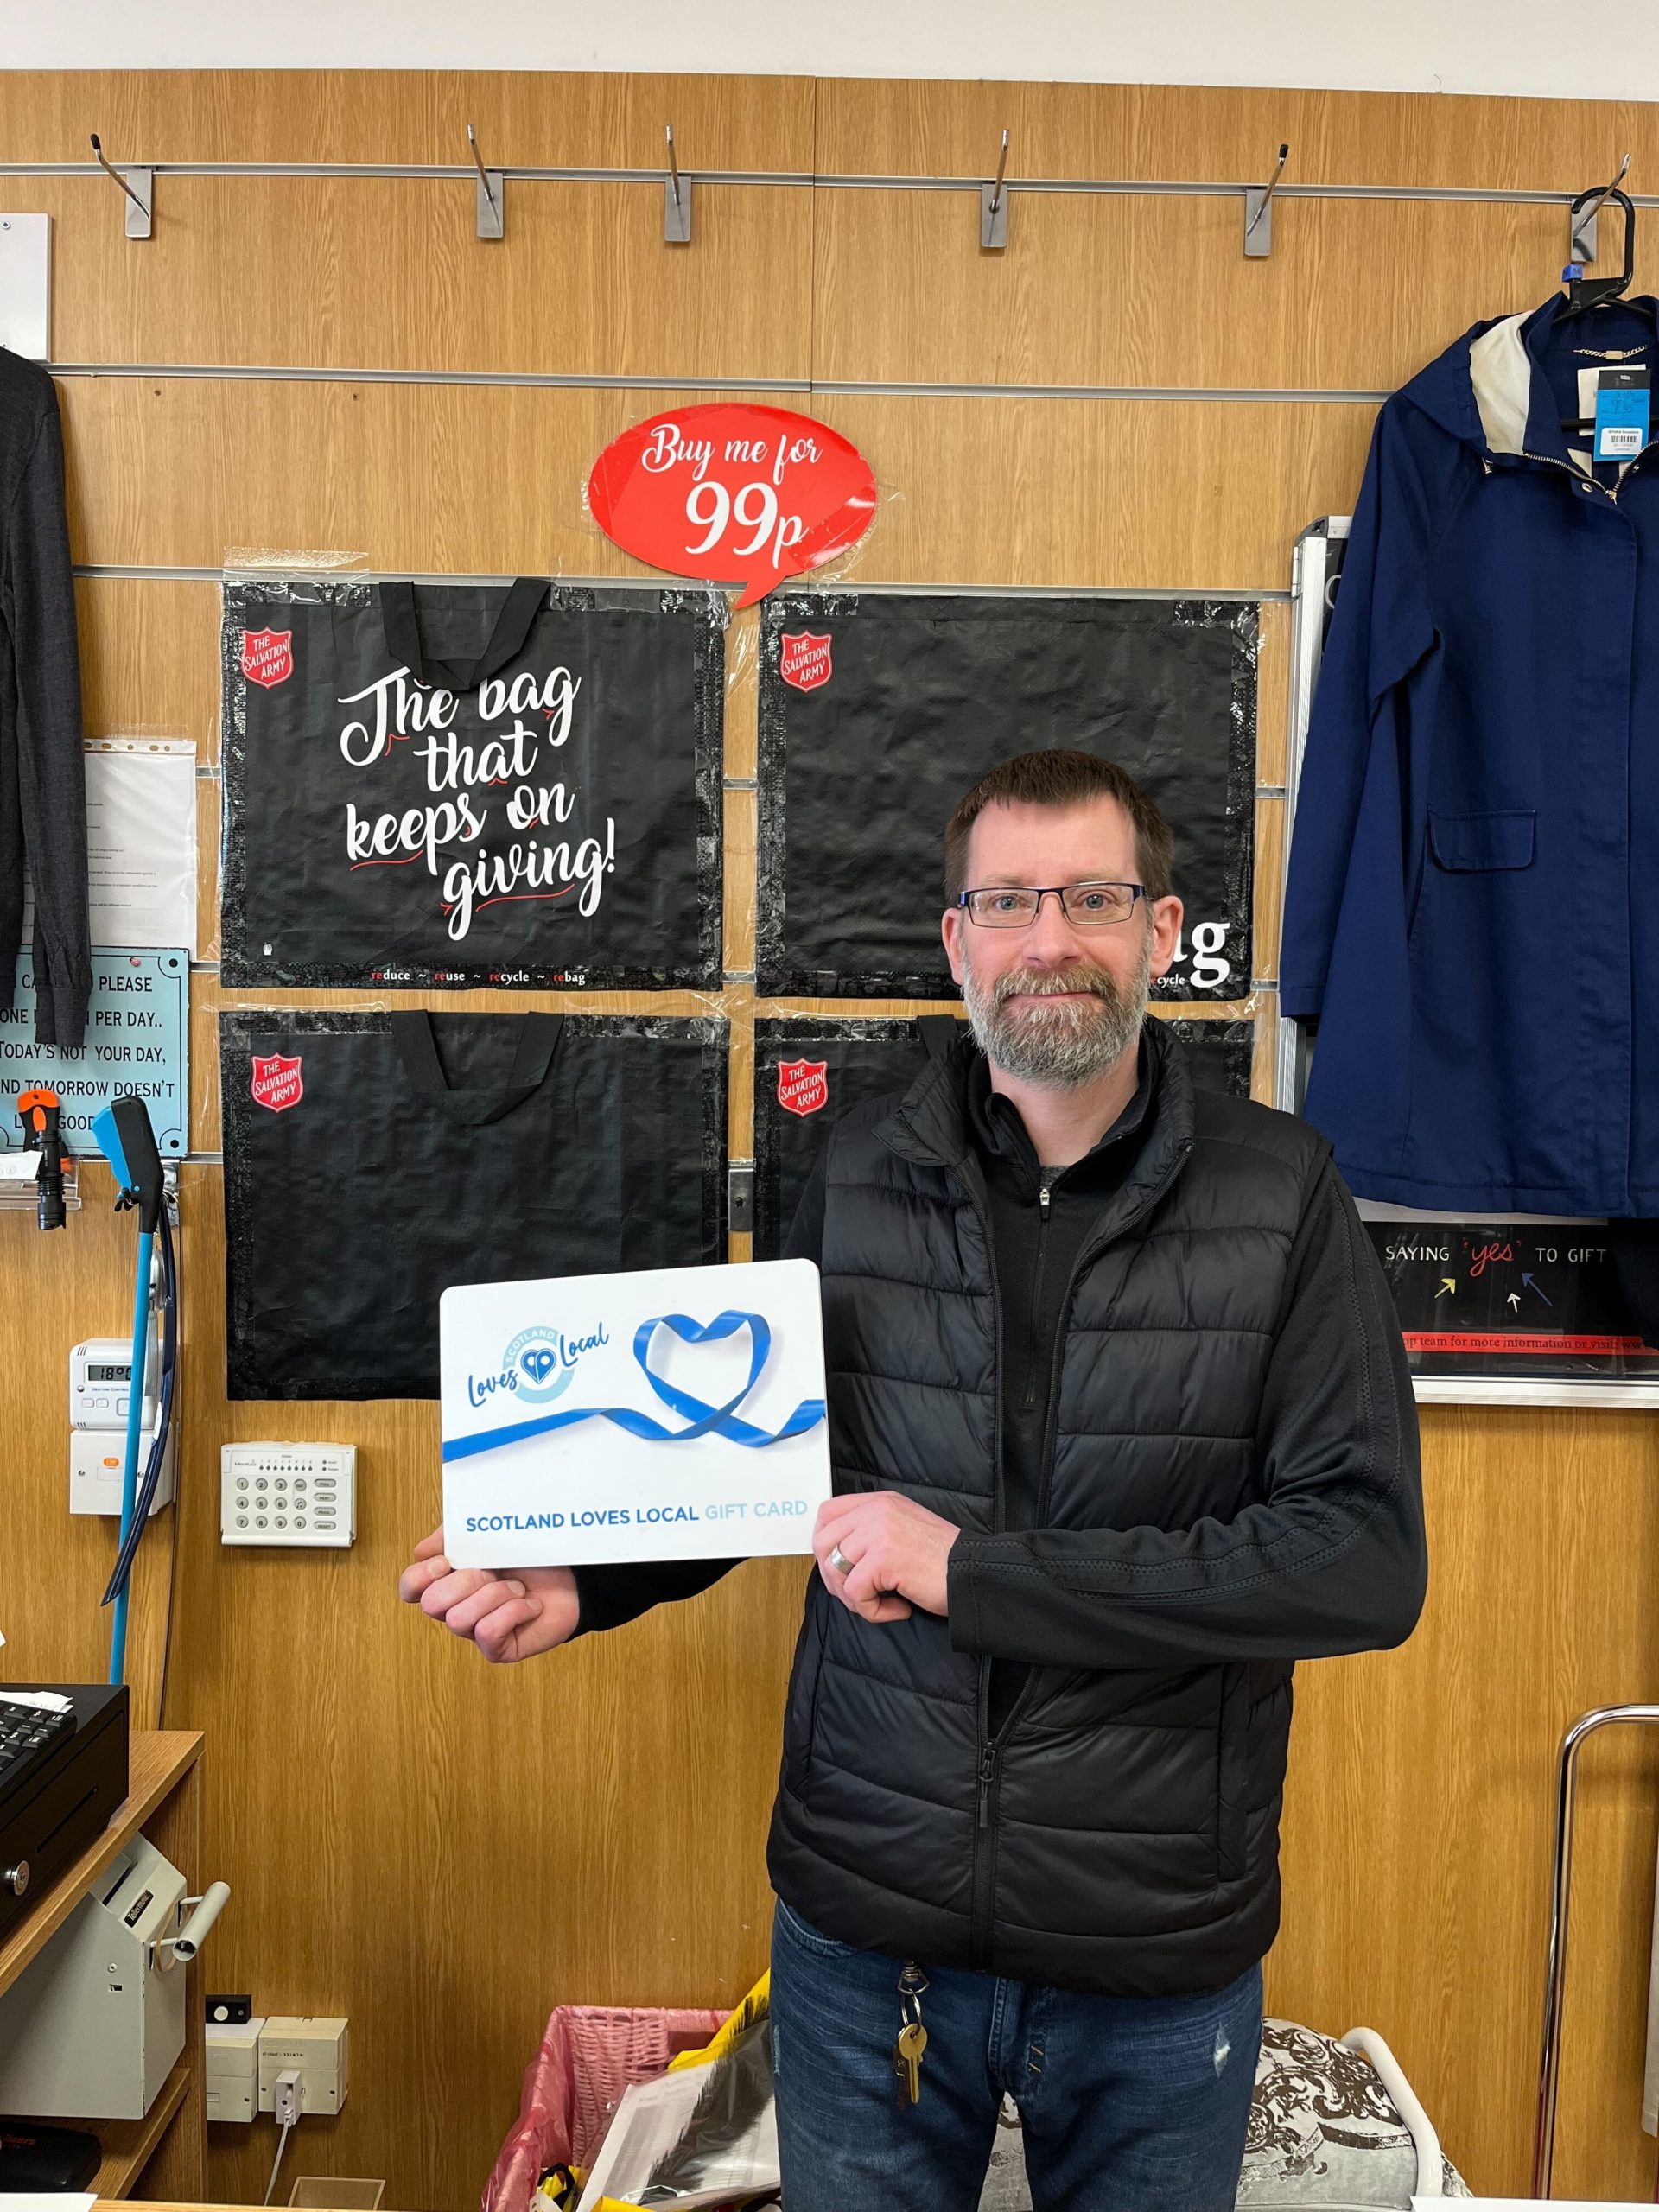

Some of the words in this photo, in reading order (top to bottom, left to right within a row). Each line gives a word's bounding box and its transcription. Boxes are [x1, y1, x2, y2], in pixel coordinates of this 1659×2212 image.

[641, 423, 715, 481] Buy
[725, 439, 768, 462] me
[773, 434, 823, 486] for
[684, 481, 810, 569] 99p
[245, 639, 288, 671] SALVATION
[252, 635, 270, 652] THE
[792, 639, 810, 655] THE
[260, 656, 286, 680] ARMY
[784, 643, 828, 675] SALVATION
[799, 659, 825, 683] ARMY
[337, 666, 459, 766] The
[478, 666, 582, 747] bag
[413, 720, 538, 791] that
[346, 792, 487, 875] keeps
[506, 783, 575, 830] on
[443, 817, 615, 940] giving!
[99, 976, 153, 993] PLEASE
[371, 969, 410, 981] reduce
[434, 971, 466, 982] reuse
[489, 970, 530, 985] recycle
[552, 971, 586, 986] rebag
[0, 1008, 29, 1024] ONE
[95, 1011, 122, 1027] PER
[127, 1011, 162, 1027] DAY..
[60, 1046, 87, 1060] NOT
[94, 1046, 131, 1062] YOUR
[136, 1047, 166, 1065] DAY,
[255, 1064, 298, 1096] SALVATION
[263, 1061, 281, 1077] THE
[788, 1065, 806, 1082] THE
[0, 1079, 20, 1094] ND
[25, 1080, 109, 1096] TOMORROW
[114, 1080, 175, 1097] DOESN'T
[270, 1081, 296, 1105] ARMY
[780, 1069, 823, 1101] SALVATION
[796, 1085, 821, 1109] ARMY
[1384, 1246, 1450, 1262] SAYING
[1535, 1248, 1558, 1262] TO
[1567, 1248, 1607, 1263] GIFT
[505, 1329, 555, 1363] SCOTLAND
[1420, 1337, 1447, 1346] team
[1451, 1335, 1467, 1346] for
[1471, 1338, 1500, 1347] more
[1503, 1336, 1571, 1349] information
[468, 1369, 518, 1408] Loves
[560, 1322, 610, 1367] Local
[466, 1513, 565, 1532] SCOTLAND
[570, 1509, 631, 1527] LOVES
[636, 1505, 699, 1523] LOCAL
[705, 1503, 747, 1520] GIFT
[753, 1500, 808, 1517] CARD
